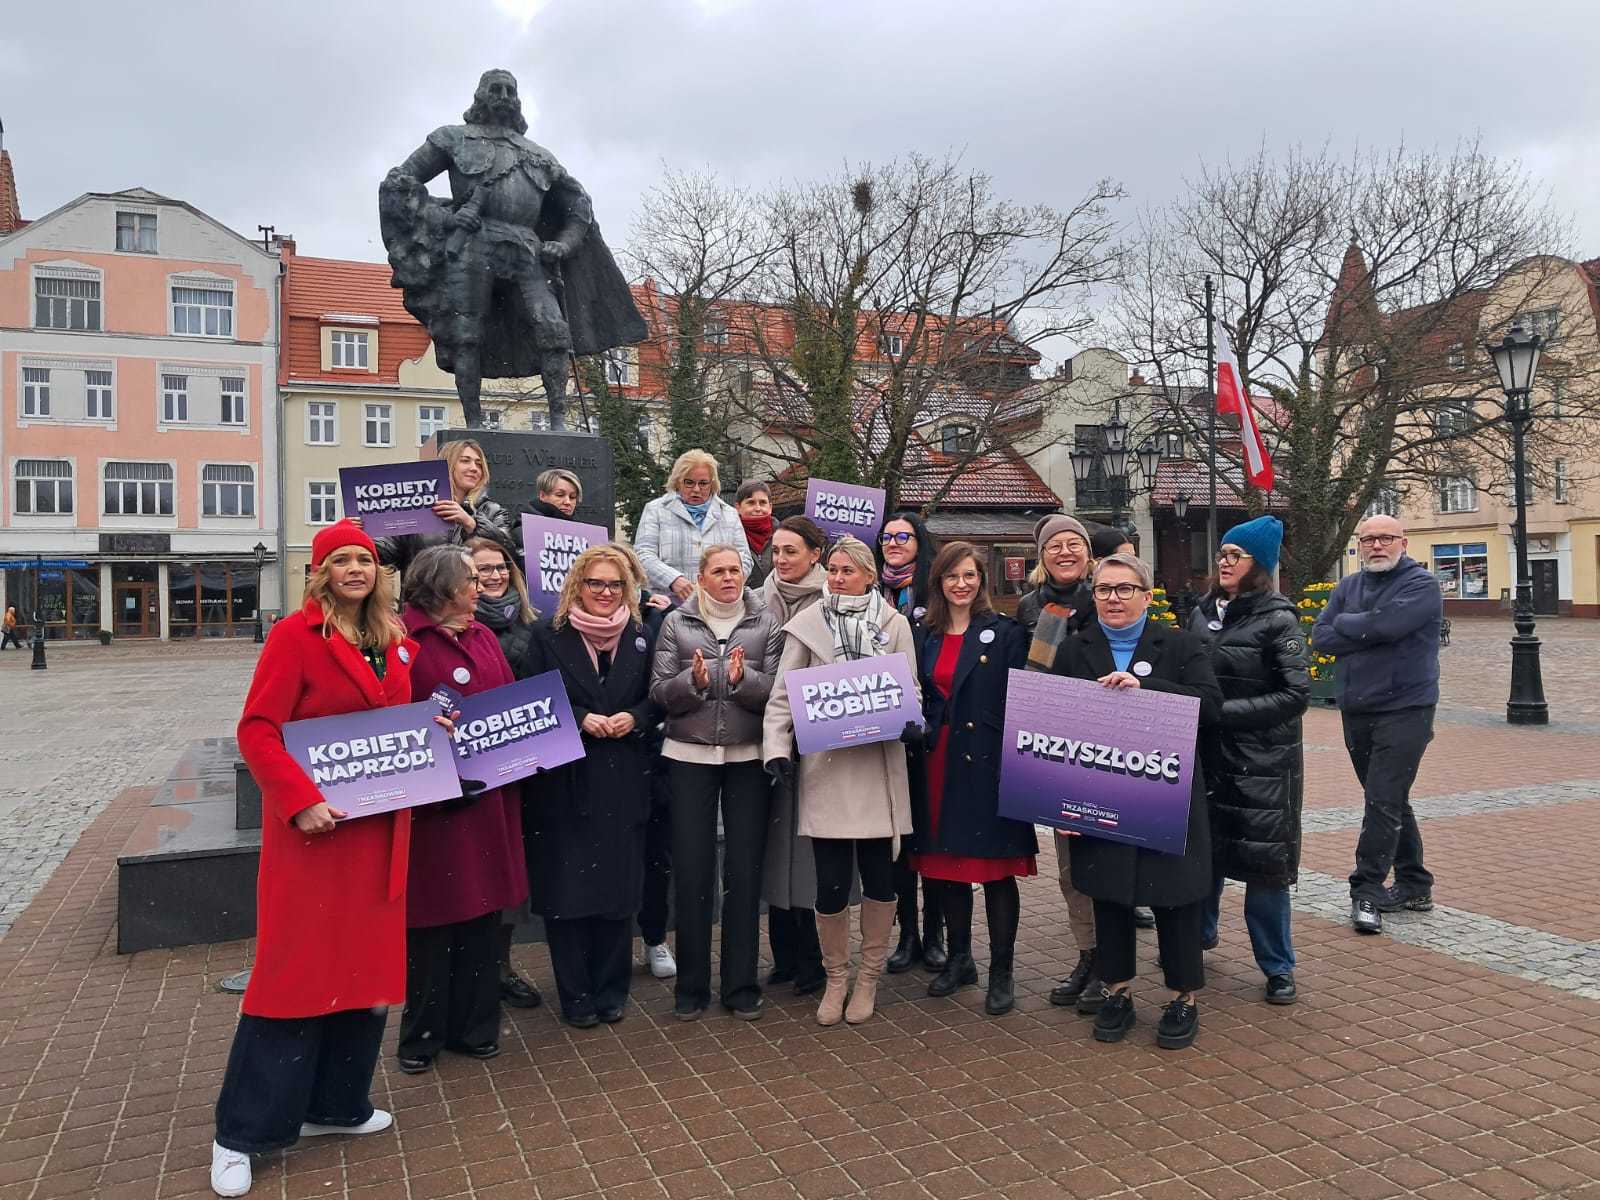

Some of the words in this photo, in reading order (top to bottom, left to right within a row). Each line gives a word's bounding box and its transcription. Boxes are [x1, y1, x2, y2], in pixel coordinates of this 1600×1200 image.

[355, 478, 439, 499] KOBIETY
[357, 493, 439, 513] NAPRZÓD!
[816, 490, 875, 512] PRAWA
[814, 504, 876, 527] KOBIET
[801, 671, 899, 702] PRAWA
[453, 696, 552, 744] KOBIETY
[805, 688, 902, 722] KOBIET
[307, 727, 429, 766] KOBIETY
[469, 714, 559, 753] TRZASKIEM
[312, 748, 436, 785] NAPRZÓD!
[1016, 729, 1181, 780] PRZYSZŁOŚĆ
[1062, 803, 1119, 820] TRZASKOWSKI
